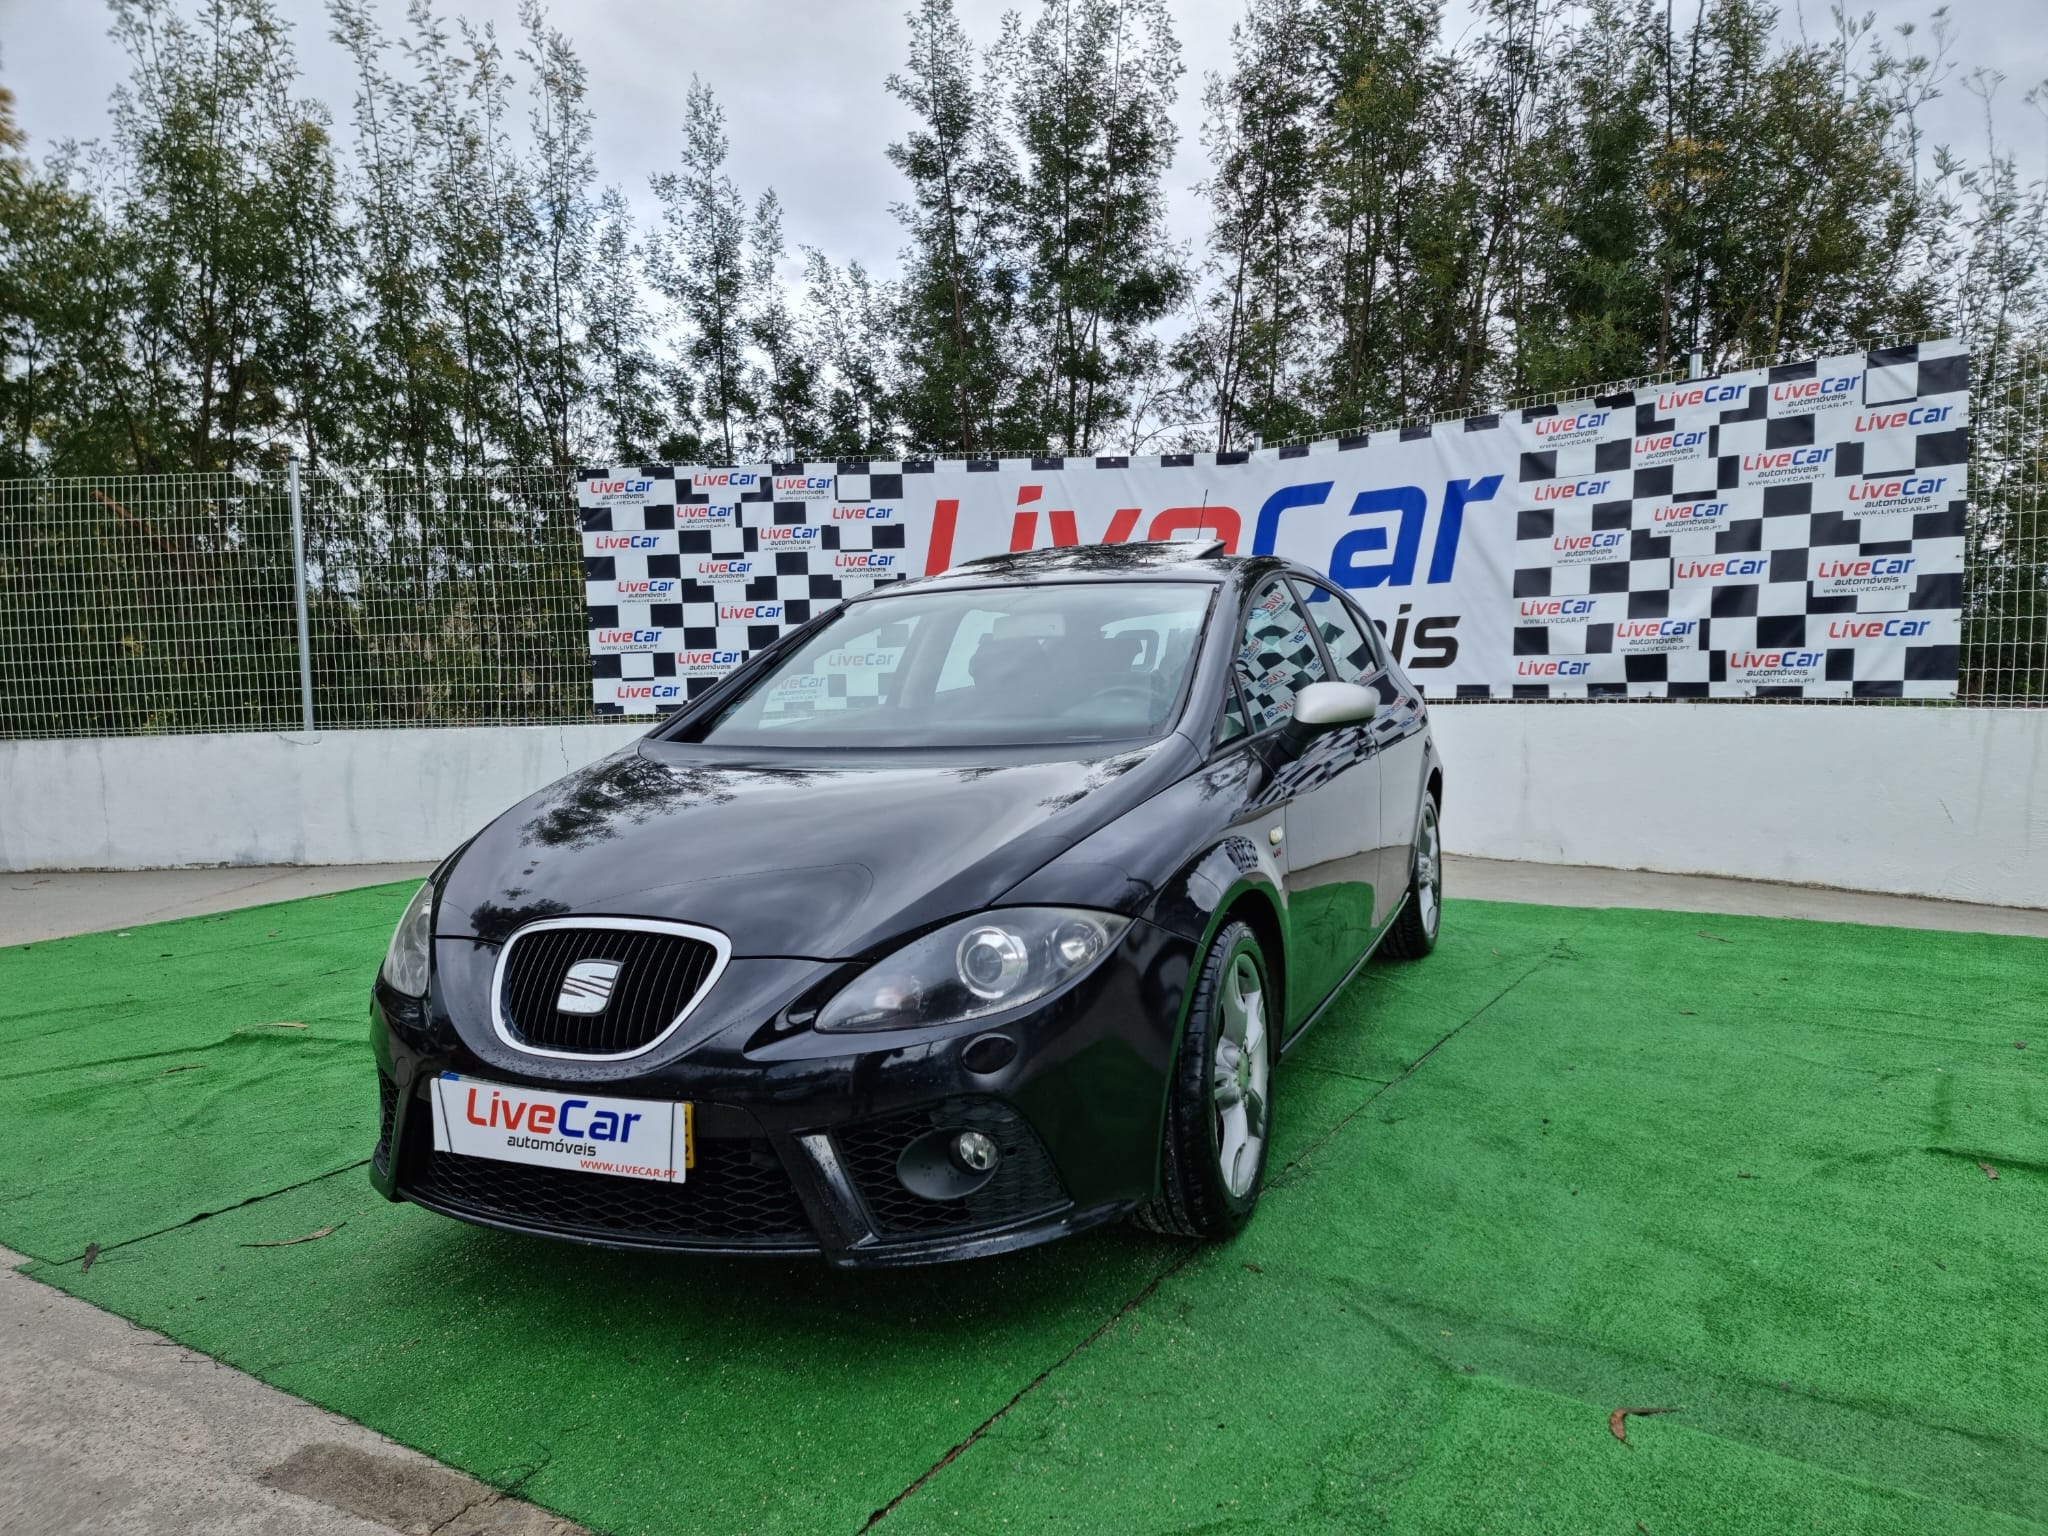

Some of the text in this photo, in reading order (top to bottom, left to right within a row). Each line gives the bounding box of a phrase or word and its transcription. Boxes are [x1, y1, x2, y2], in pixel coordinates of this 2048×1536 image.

[1774, 376, 1861, 401] LiveCar
[1658, 384, 1747, 411] LiveCar
[1535, 412, 1610, 436] LiveCar
[1855, 405, 1953, 432] LiveCar
[1634, 431, 1708, 454] LiveCar
[1743, 447, 1834, 472] LiveCar
[591, 479, 653, 494] LiveCar
[694, 472, 758, 486] LiveCar
[776, 477, 833, 489] LiveCar
[1534, 480, 1610, 501] LiveCar
[1848, 477, 1948, 501] LiveCar
[677, 505, 734, 518] LiveCar
[832, 506, 893, 519] LiveCar
[1654, 503, 1729, 522] LiveCar
[760, 526, 820, 540] LiveCar
[596, 536, 660, 549] LiveCar
[1554, 533, 1625, 551] LiveCar
[698, 561, 753, 574] LiveCar
[835, 554, 896, 567] LiveCar
[1677, 559, 1768, 579] LiveCar
[1818, 558, 1916, 578] LiveCar
[618, 580, 675, 593] LiveCar
[721, 605, 783, 619] LiveCar
[1520, 600, 1597, 616] LiveCar
[598, 630, 663, 644] LiveCar
[1617, 621, 1697, 638] LiveCar
[1829, 619, 1931, 639] LiveCar
[678, 651, 741, 665] LiveCar
[829, 652, 894, 667] LiveCar
[1730, 651, 1824, 669] LiveCar
[1518, 661, 1591, 676] LiveCar
[617, 685, 681, 699] LiveCar
[466, 1087, 642, 1143] LiveCar
[506, 1135, 597, 1157] automóveis
[580, 1159, 678, 1179] WWW.LIVECAR.PT
